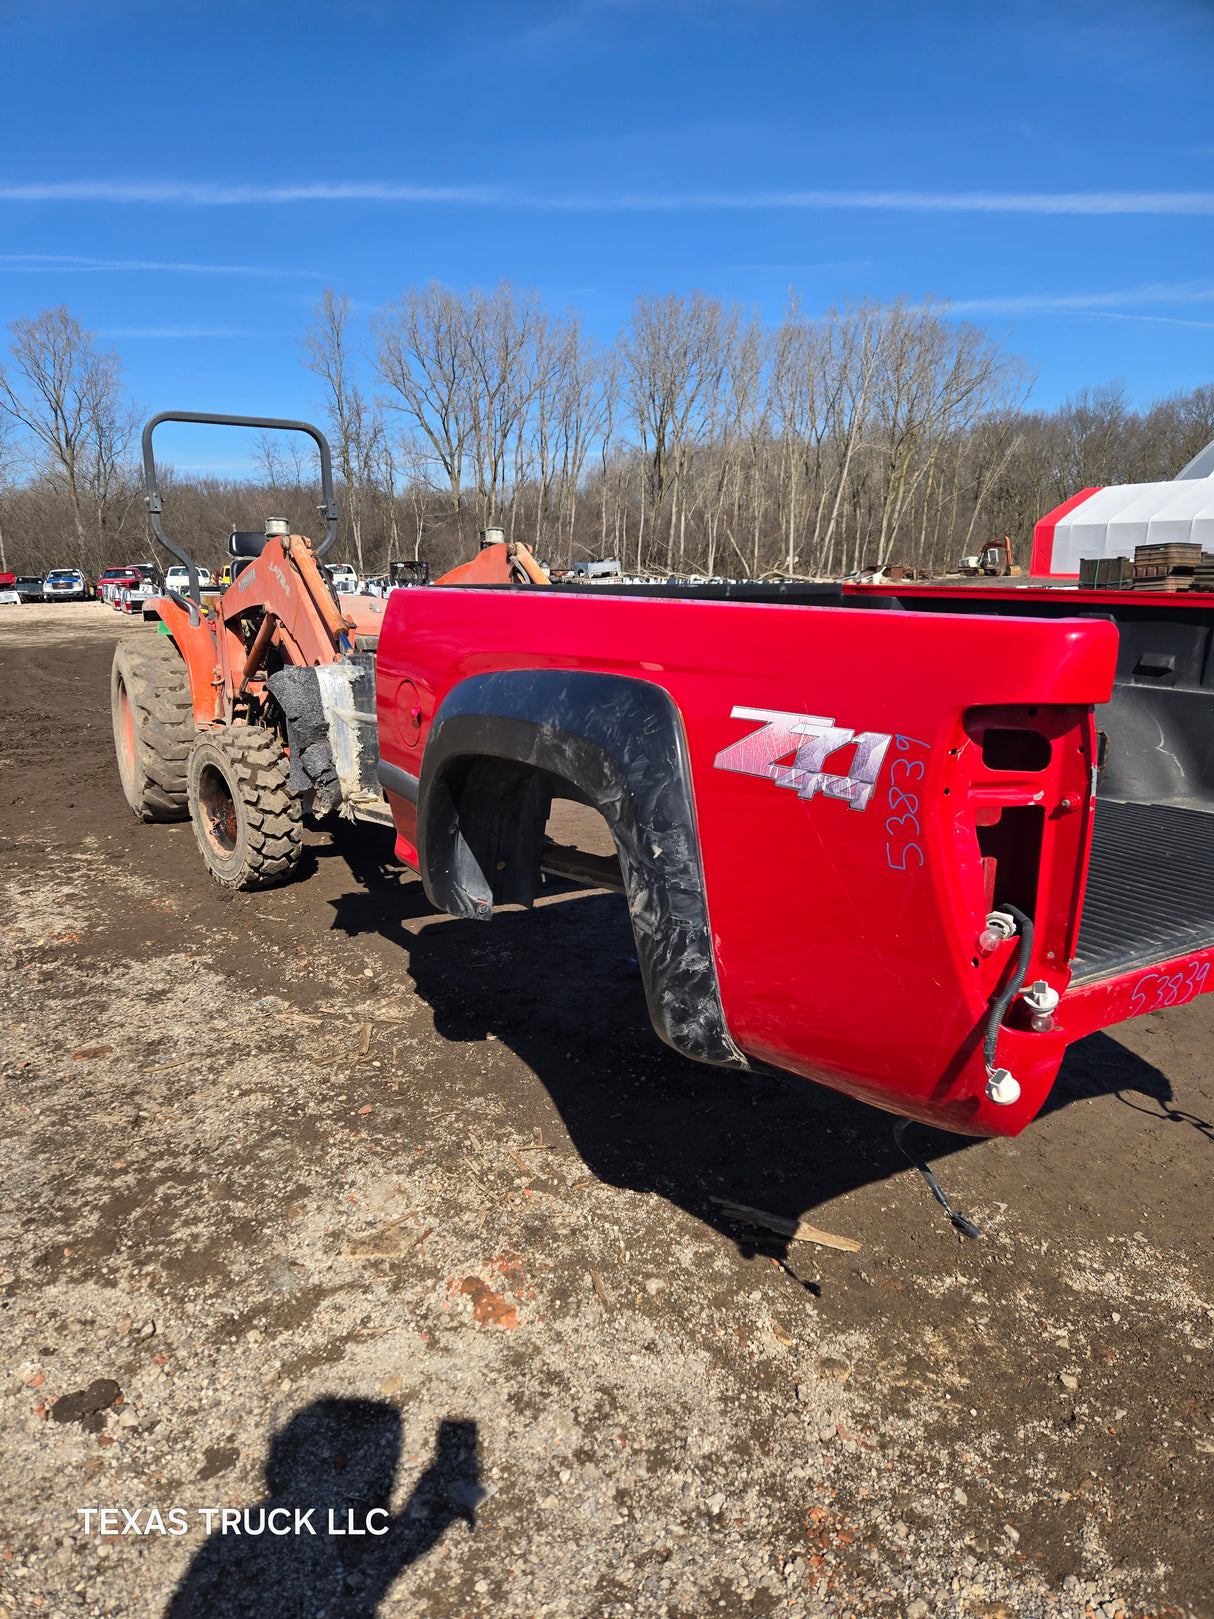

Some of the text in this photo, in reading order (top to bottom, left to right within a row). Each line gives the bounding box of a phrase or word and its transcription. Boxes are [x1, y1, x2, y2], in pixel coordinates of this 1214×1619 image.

[713, 705, 893, 784] Z71
[886, 733, 931, 870] 53839
[1126, 961, 1211, 1020] 53839
